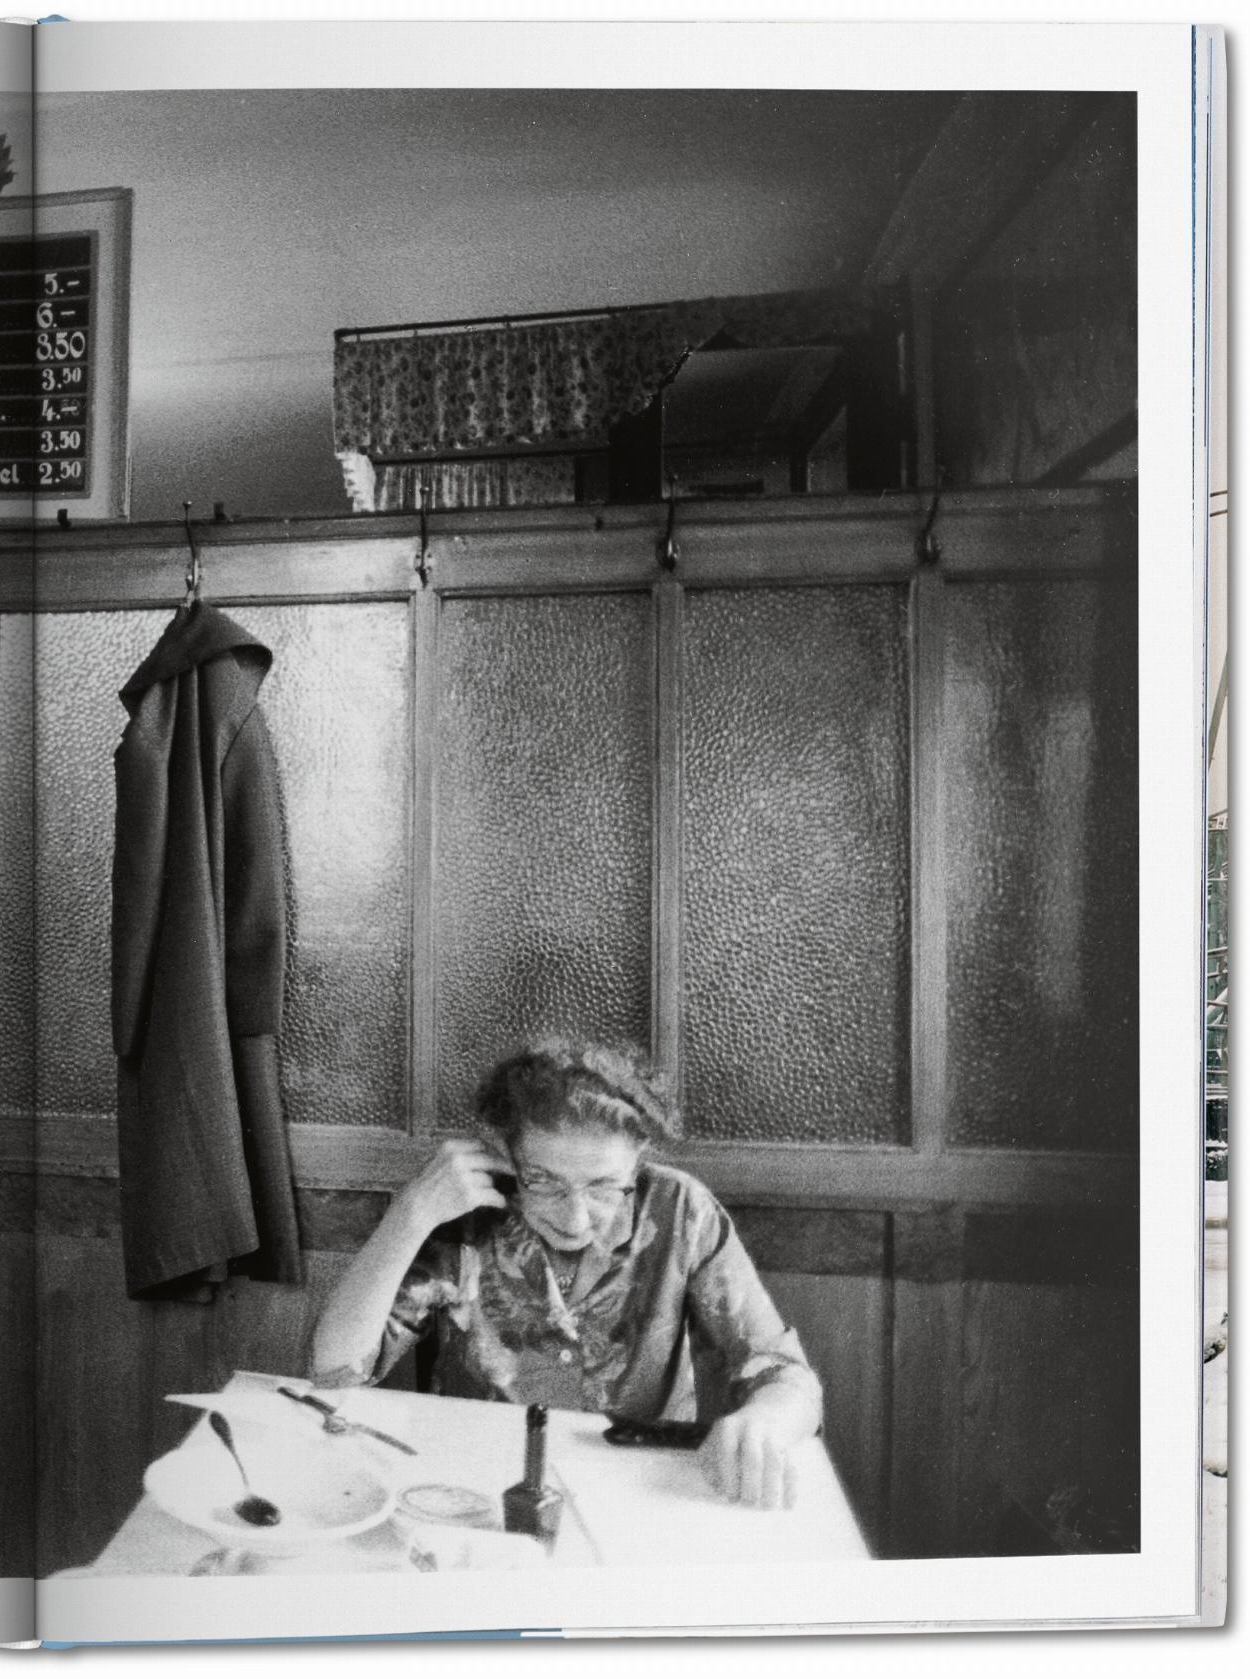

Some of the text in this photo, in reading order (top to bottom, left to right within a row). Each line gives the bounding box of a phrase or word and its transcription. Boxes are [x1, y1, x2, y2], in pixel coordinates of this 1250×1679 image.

[36, 331, 85, 361] 8.50
[42, 367, 82, 391] 3.50
[40, 430, 81, 453] 3.50
[38, 461, 82, 485] 2.50
